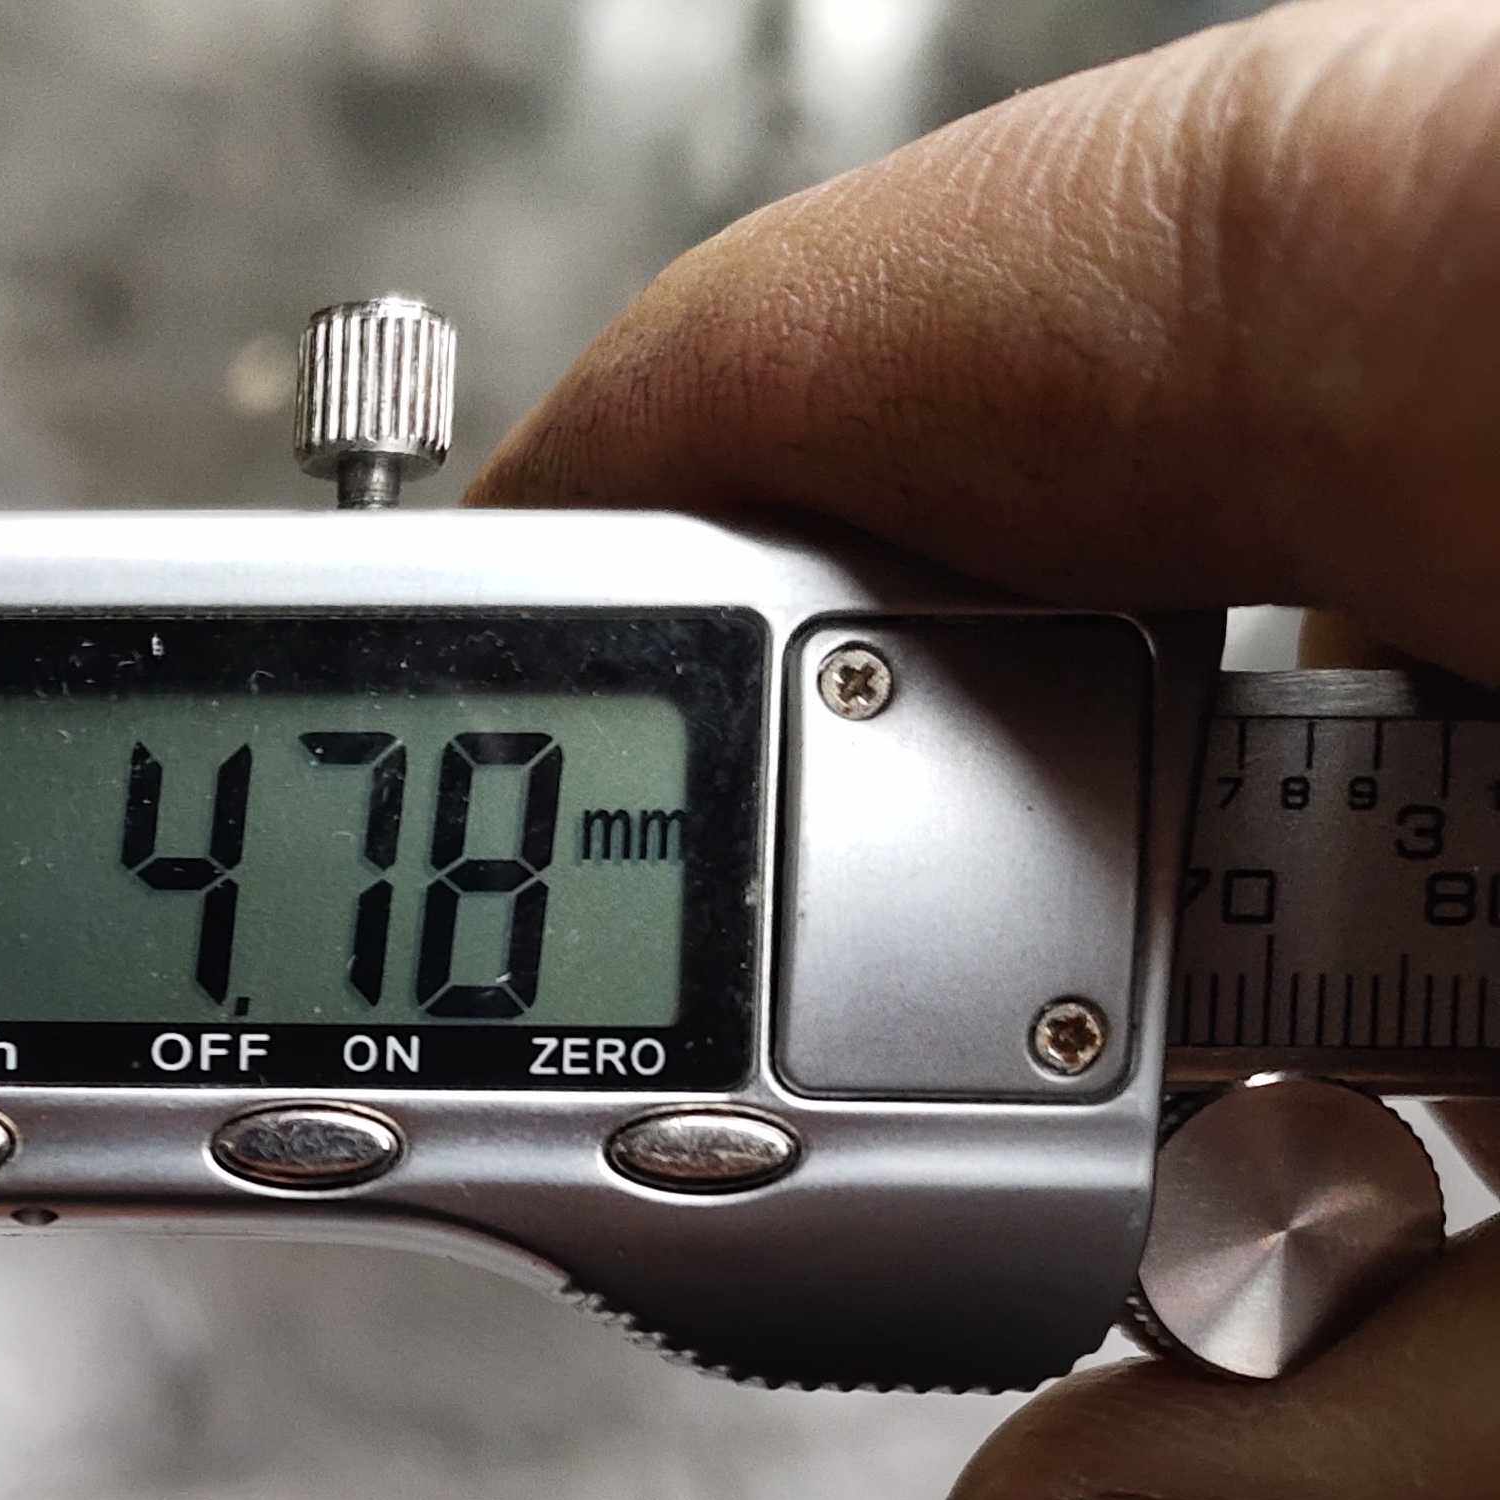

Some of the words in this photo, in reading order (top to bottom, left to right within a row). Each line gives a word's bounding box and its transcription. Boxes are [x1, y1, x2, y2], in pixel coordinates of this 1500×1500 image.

[1217, 776, 1245, 809] 7
[1281, 776, 1310, 810] 8
[1347, 776, 1379, 810] 9
[581, 808, 687, 860] mm
[1395, 805, 1447, 860] 3
[150, 1032, 271, 1073] OFF
[342, 1034, 421, 1074] ON
[528, 1037, 667, 1077] ZERO
